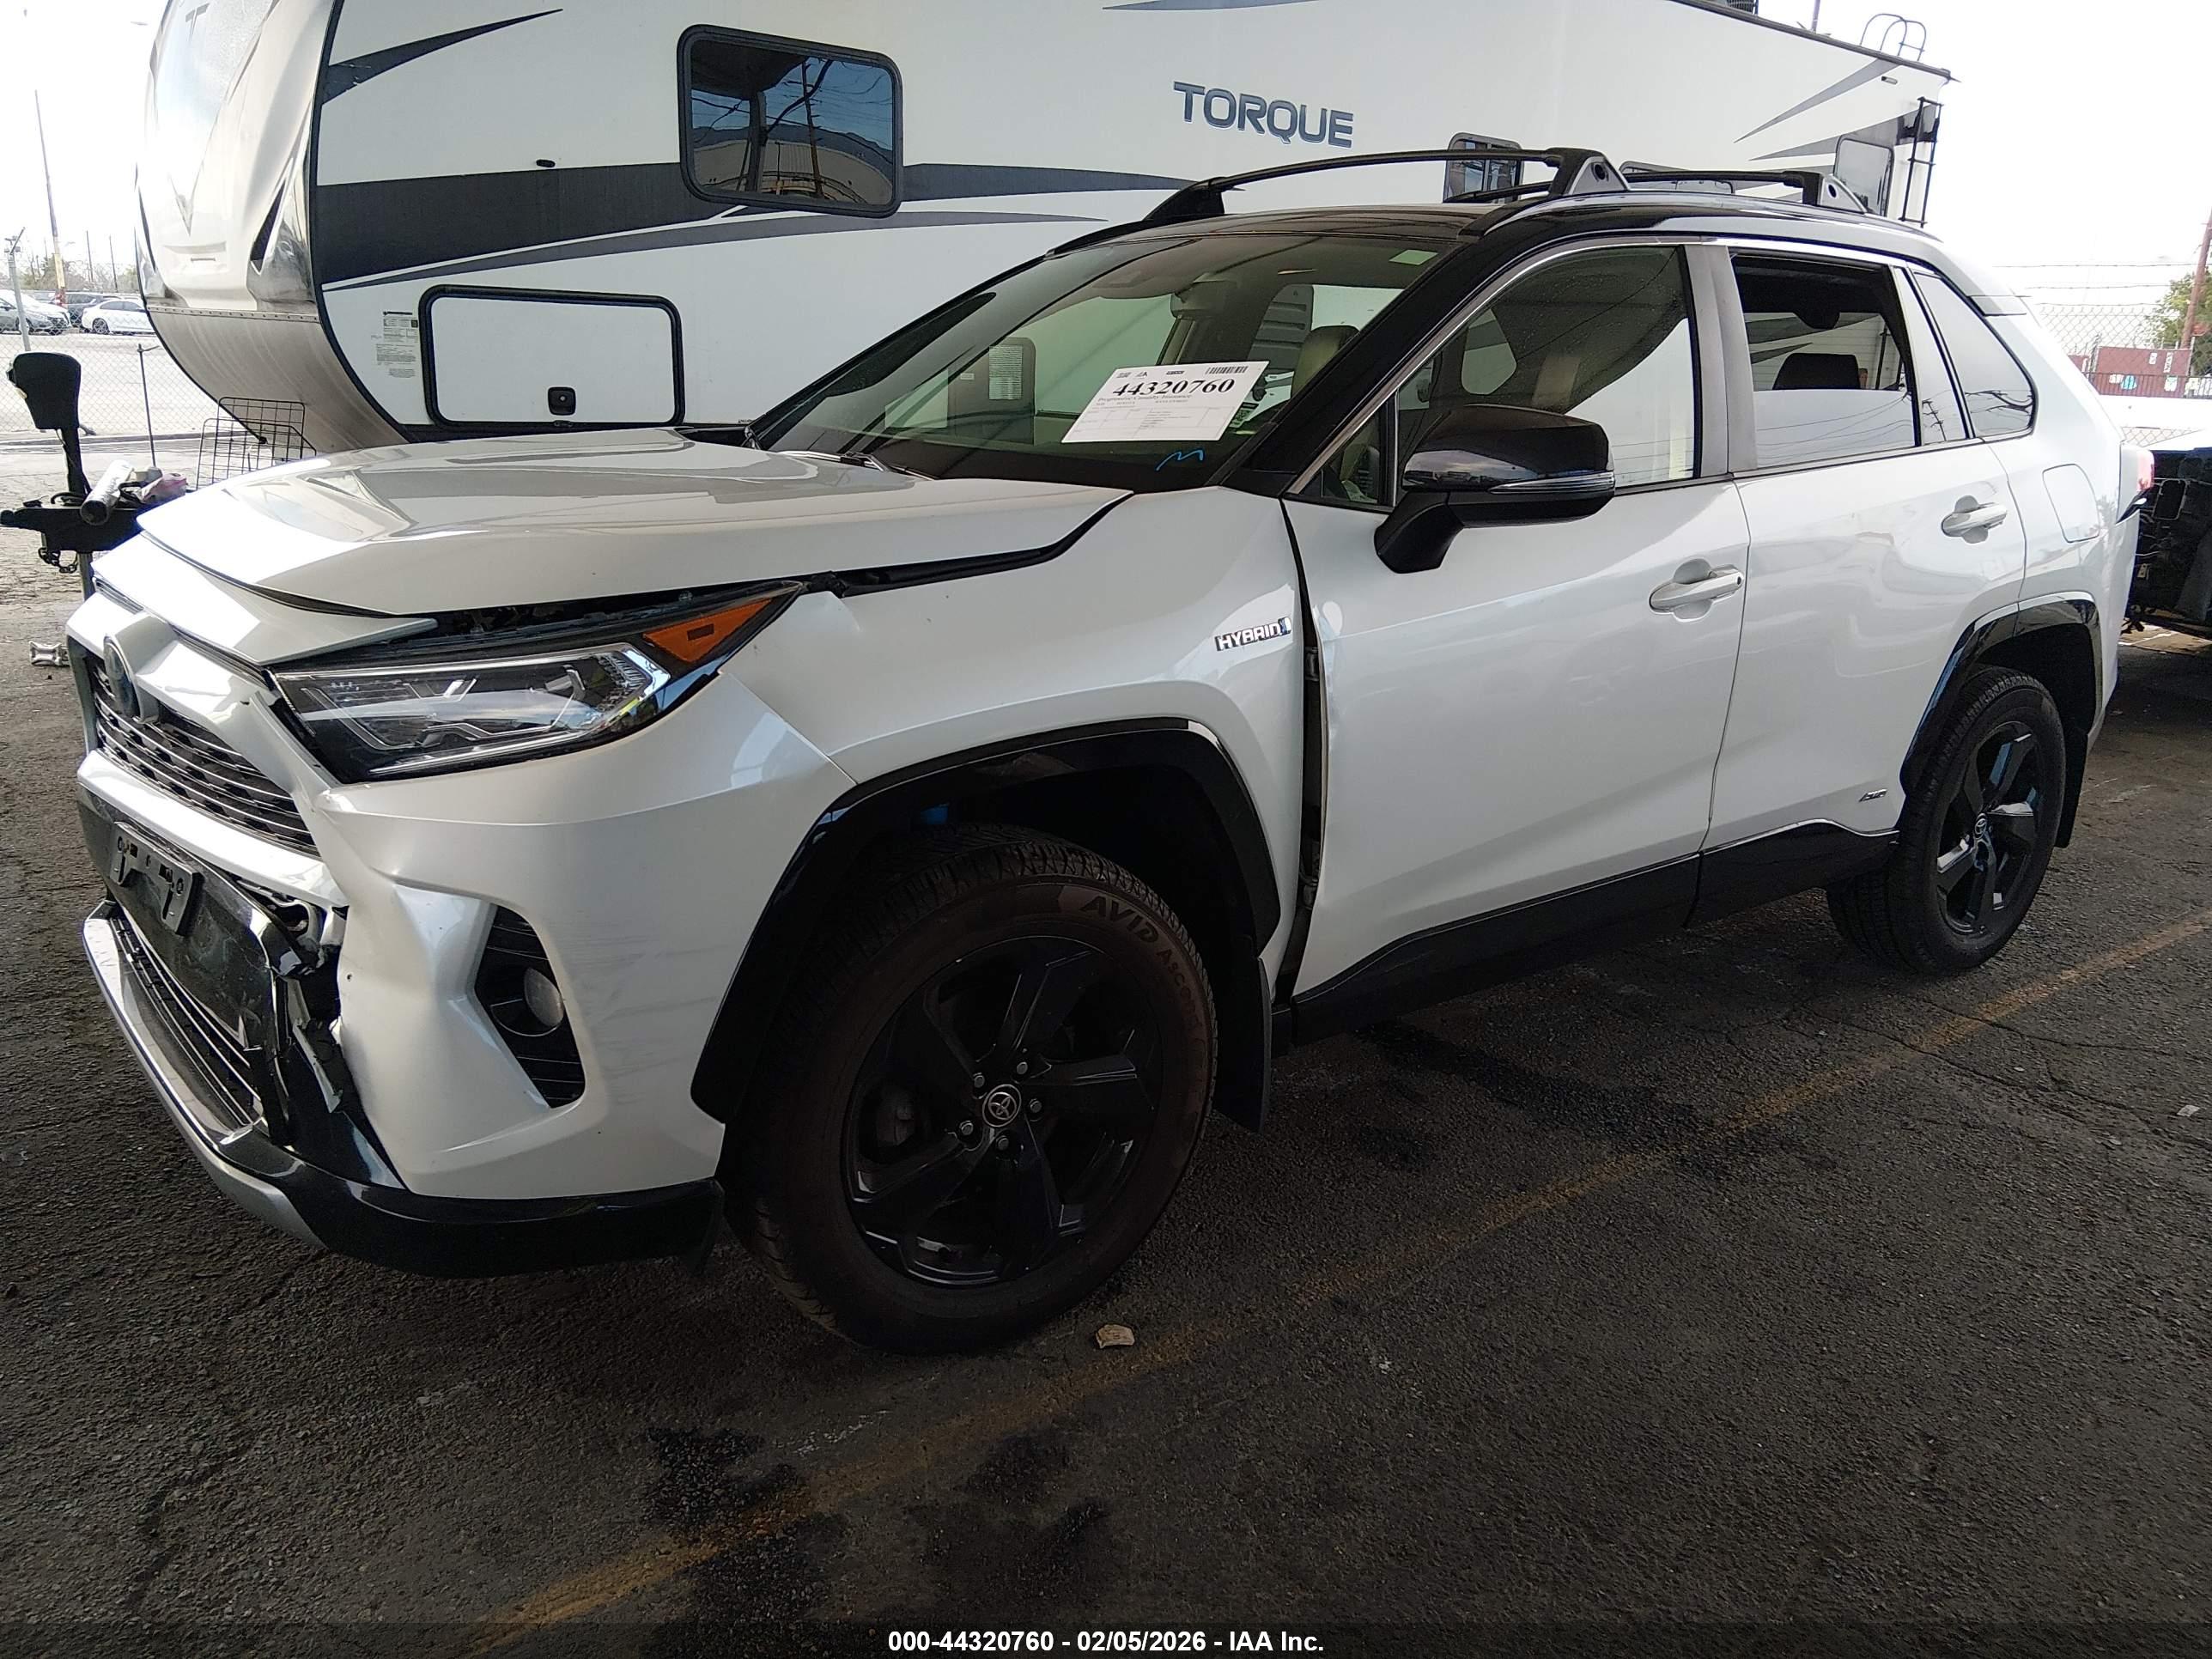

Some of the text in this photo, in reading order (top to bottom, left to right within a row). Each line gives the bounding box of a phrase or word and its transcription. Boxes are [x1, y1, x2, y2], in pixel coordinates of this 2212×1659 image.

[1174, 82, 1354, 149] TORQUE
[1113, 378, 1235, 396] 44320760
[1215, 622, 1283, 651] HYBRID
[1080, 896, 1158, 943] AVID
